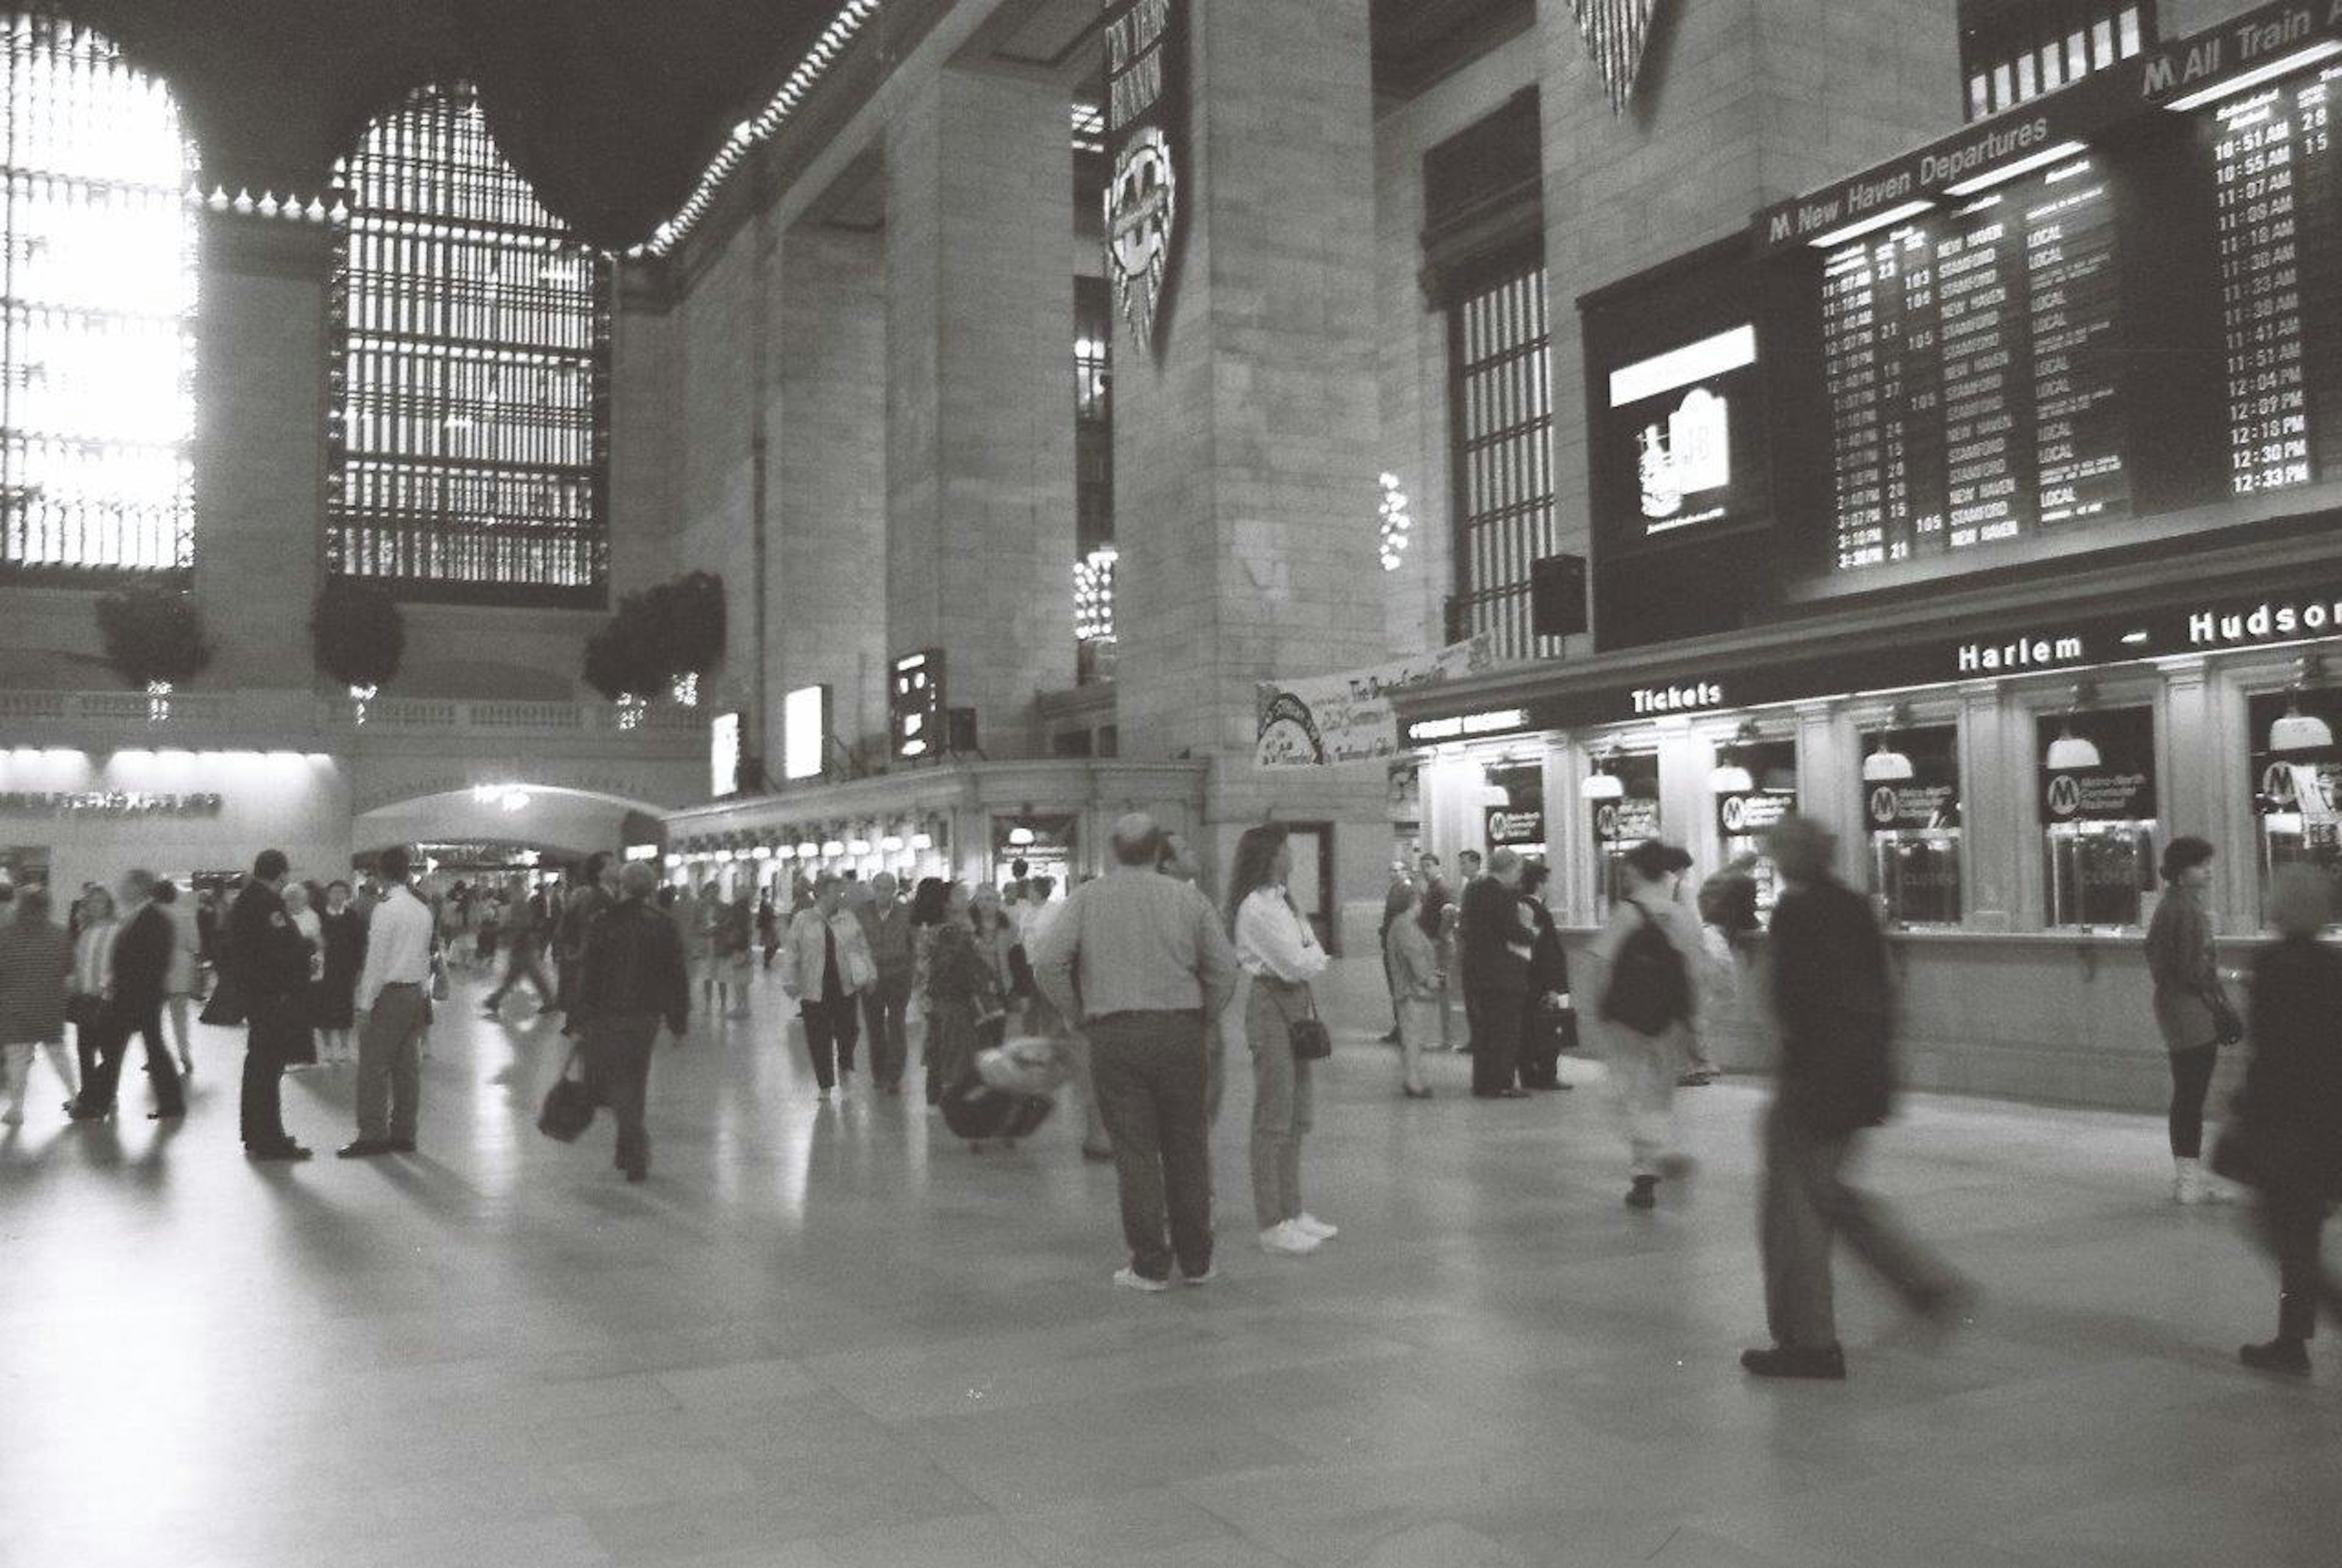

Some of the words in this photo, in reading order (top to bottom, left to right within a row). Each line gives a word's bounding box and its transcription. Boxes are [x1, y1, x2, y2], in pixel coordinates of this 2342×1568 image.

[2182, 38, 2221, 84] All
[2237, 9, 2310, 60] Train
[2215, 129, 2262, 160] 10:51
[2265, 121, 2290, 144] AM
[2302, 107, 2327, 131] 28
[1797, 198, 1840, 233] New
[1848, 171, 1911, 215] Haven
[1920, 117, 2048, 185] Departures
[2216, 154, 2265, 184] 10:55
[2268, 145, 2290, 167] AM
[2304, 132, 2329, 155] 15
[2268, 171, 2291, 192] AM
[2269, 194, 2293, 215] AM
[1937, 238, 1963, 259] NEW
[1939, 248, 1995, 279] STAMFORD
[2027, 224, 2063, 248] LOCAL
[1940, 269, 1997, 299] STAMFORD
[2029, 246, 2063, 270] LOCAL
[1941, 300, 1966, 320] NEW
[1942, 310, 1999, 340] STAMFORD
[2031, 290, 2067, 313] LOCAL
[1942, 332, 1999, 361] STAMFORD
[2032, 312, 2067, 334] LOCAL
[1944, 362, 1968, 381] NEW
[1945, 373, 2002, 402] STAMFORD
[2035, 355, 2070, 378] LOCAL
[1947, 396, 2004, 422] STAMFORD
[2036, 378, 2071, 399] LOCAL
[1947, 425, 1971, 443] NEW
[1949, 437, 2005, 464] STAMFORD
[2038, 421, 2074, 443] LOCAL
[2282, 415, 2304, 434] PM
[1949, 459, 2006, 484] STAMFORD
[2038, 443, 2074, 465] LOCAL
[2233, 443, 2282, 469] 12:30
[2284, 439, 2307, 458] PM
[2233, 467, 2283, 493] 12:33
[2285, 460, 2308, 484] PM
[1950, 487, 1974, 506] NEW
[1950, 501, 2008, 527] STAMFORD
[2040, 486, 2077, 508] LOCAL
[1951, 528, 1977, 547] NEW
[1958, 635, 2082, 670] Harlem
[1631, 681, 1723, 714] Tickets
